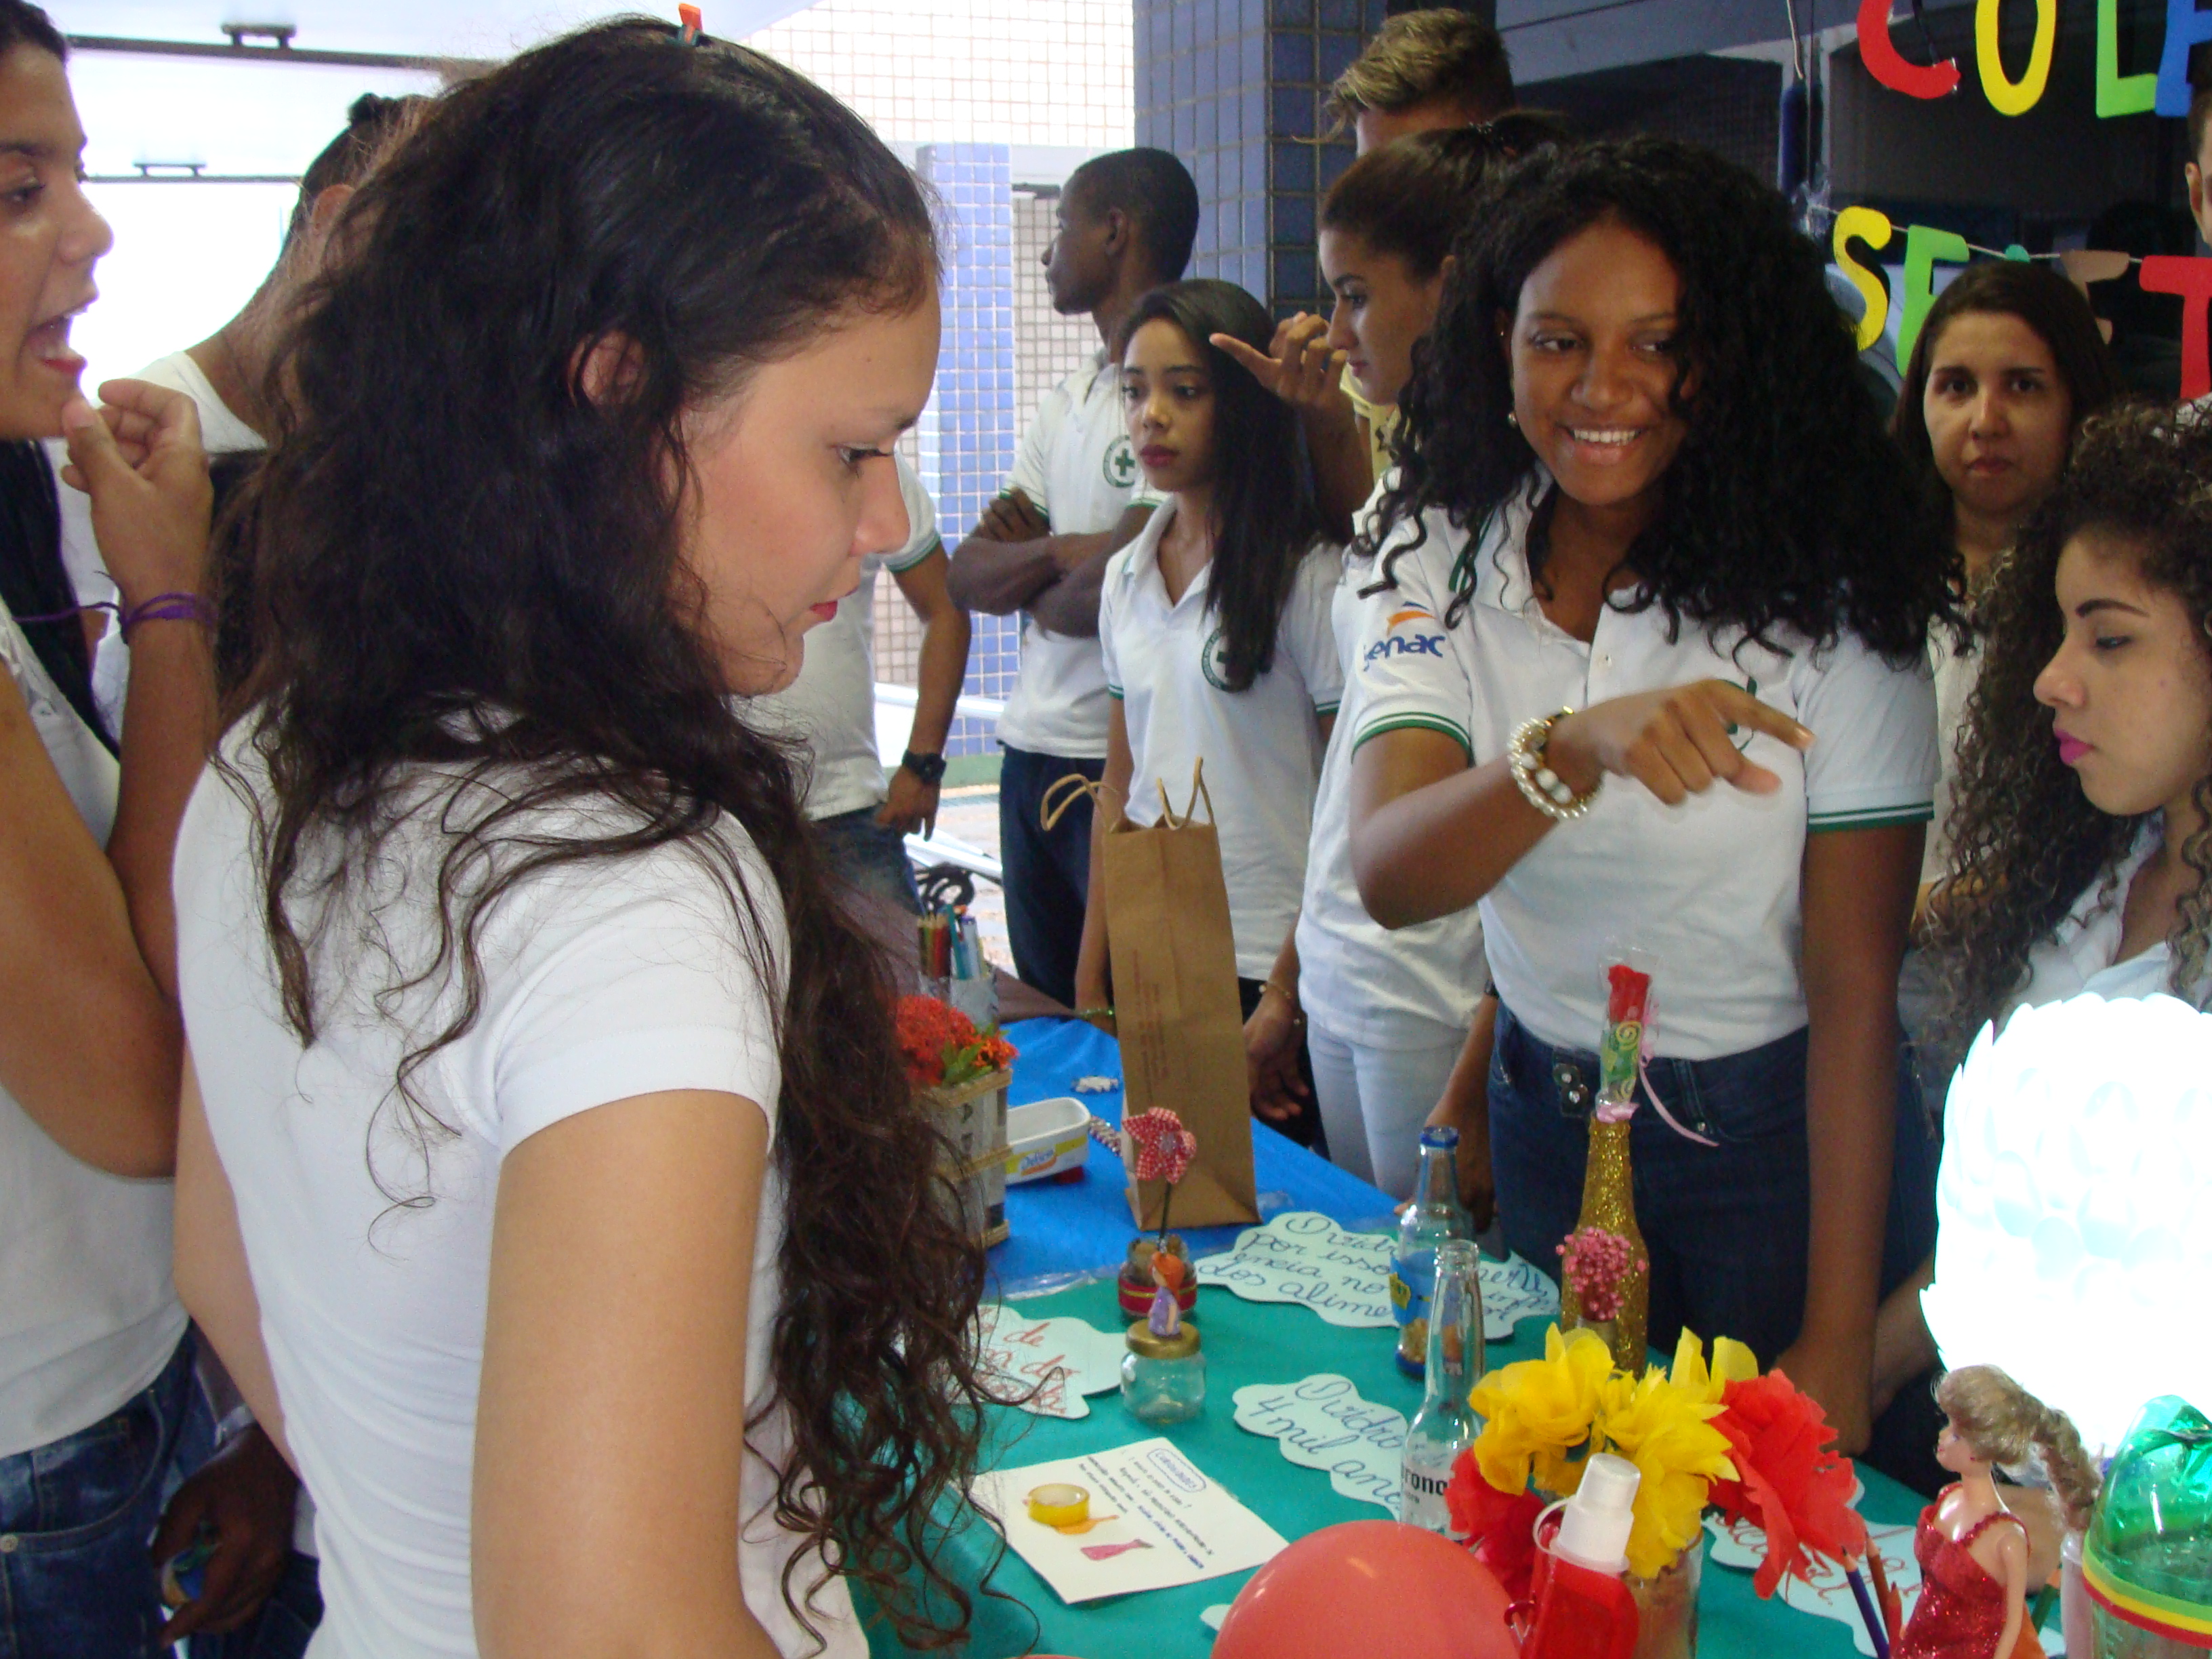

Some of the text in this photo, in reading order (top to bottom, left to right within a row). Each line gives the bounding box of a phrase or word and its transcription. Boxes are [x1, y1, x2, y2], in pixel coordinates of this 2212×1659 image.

[1363, 634, 1446, 672] enac
[1242, 1231, 1307, 1254] por
[1277, 1282, 1392, 1317] alime
[1249, 1396, 1360, 1454] 4 mil
[1332, 1460, 1401, 1511] ano
